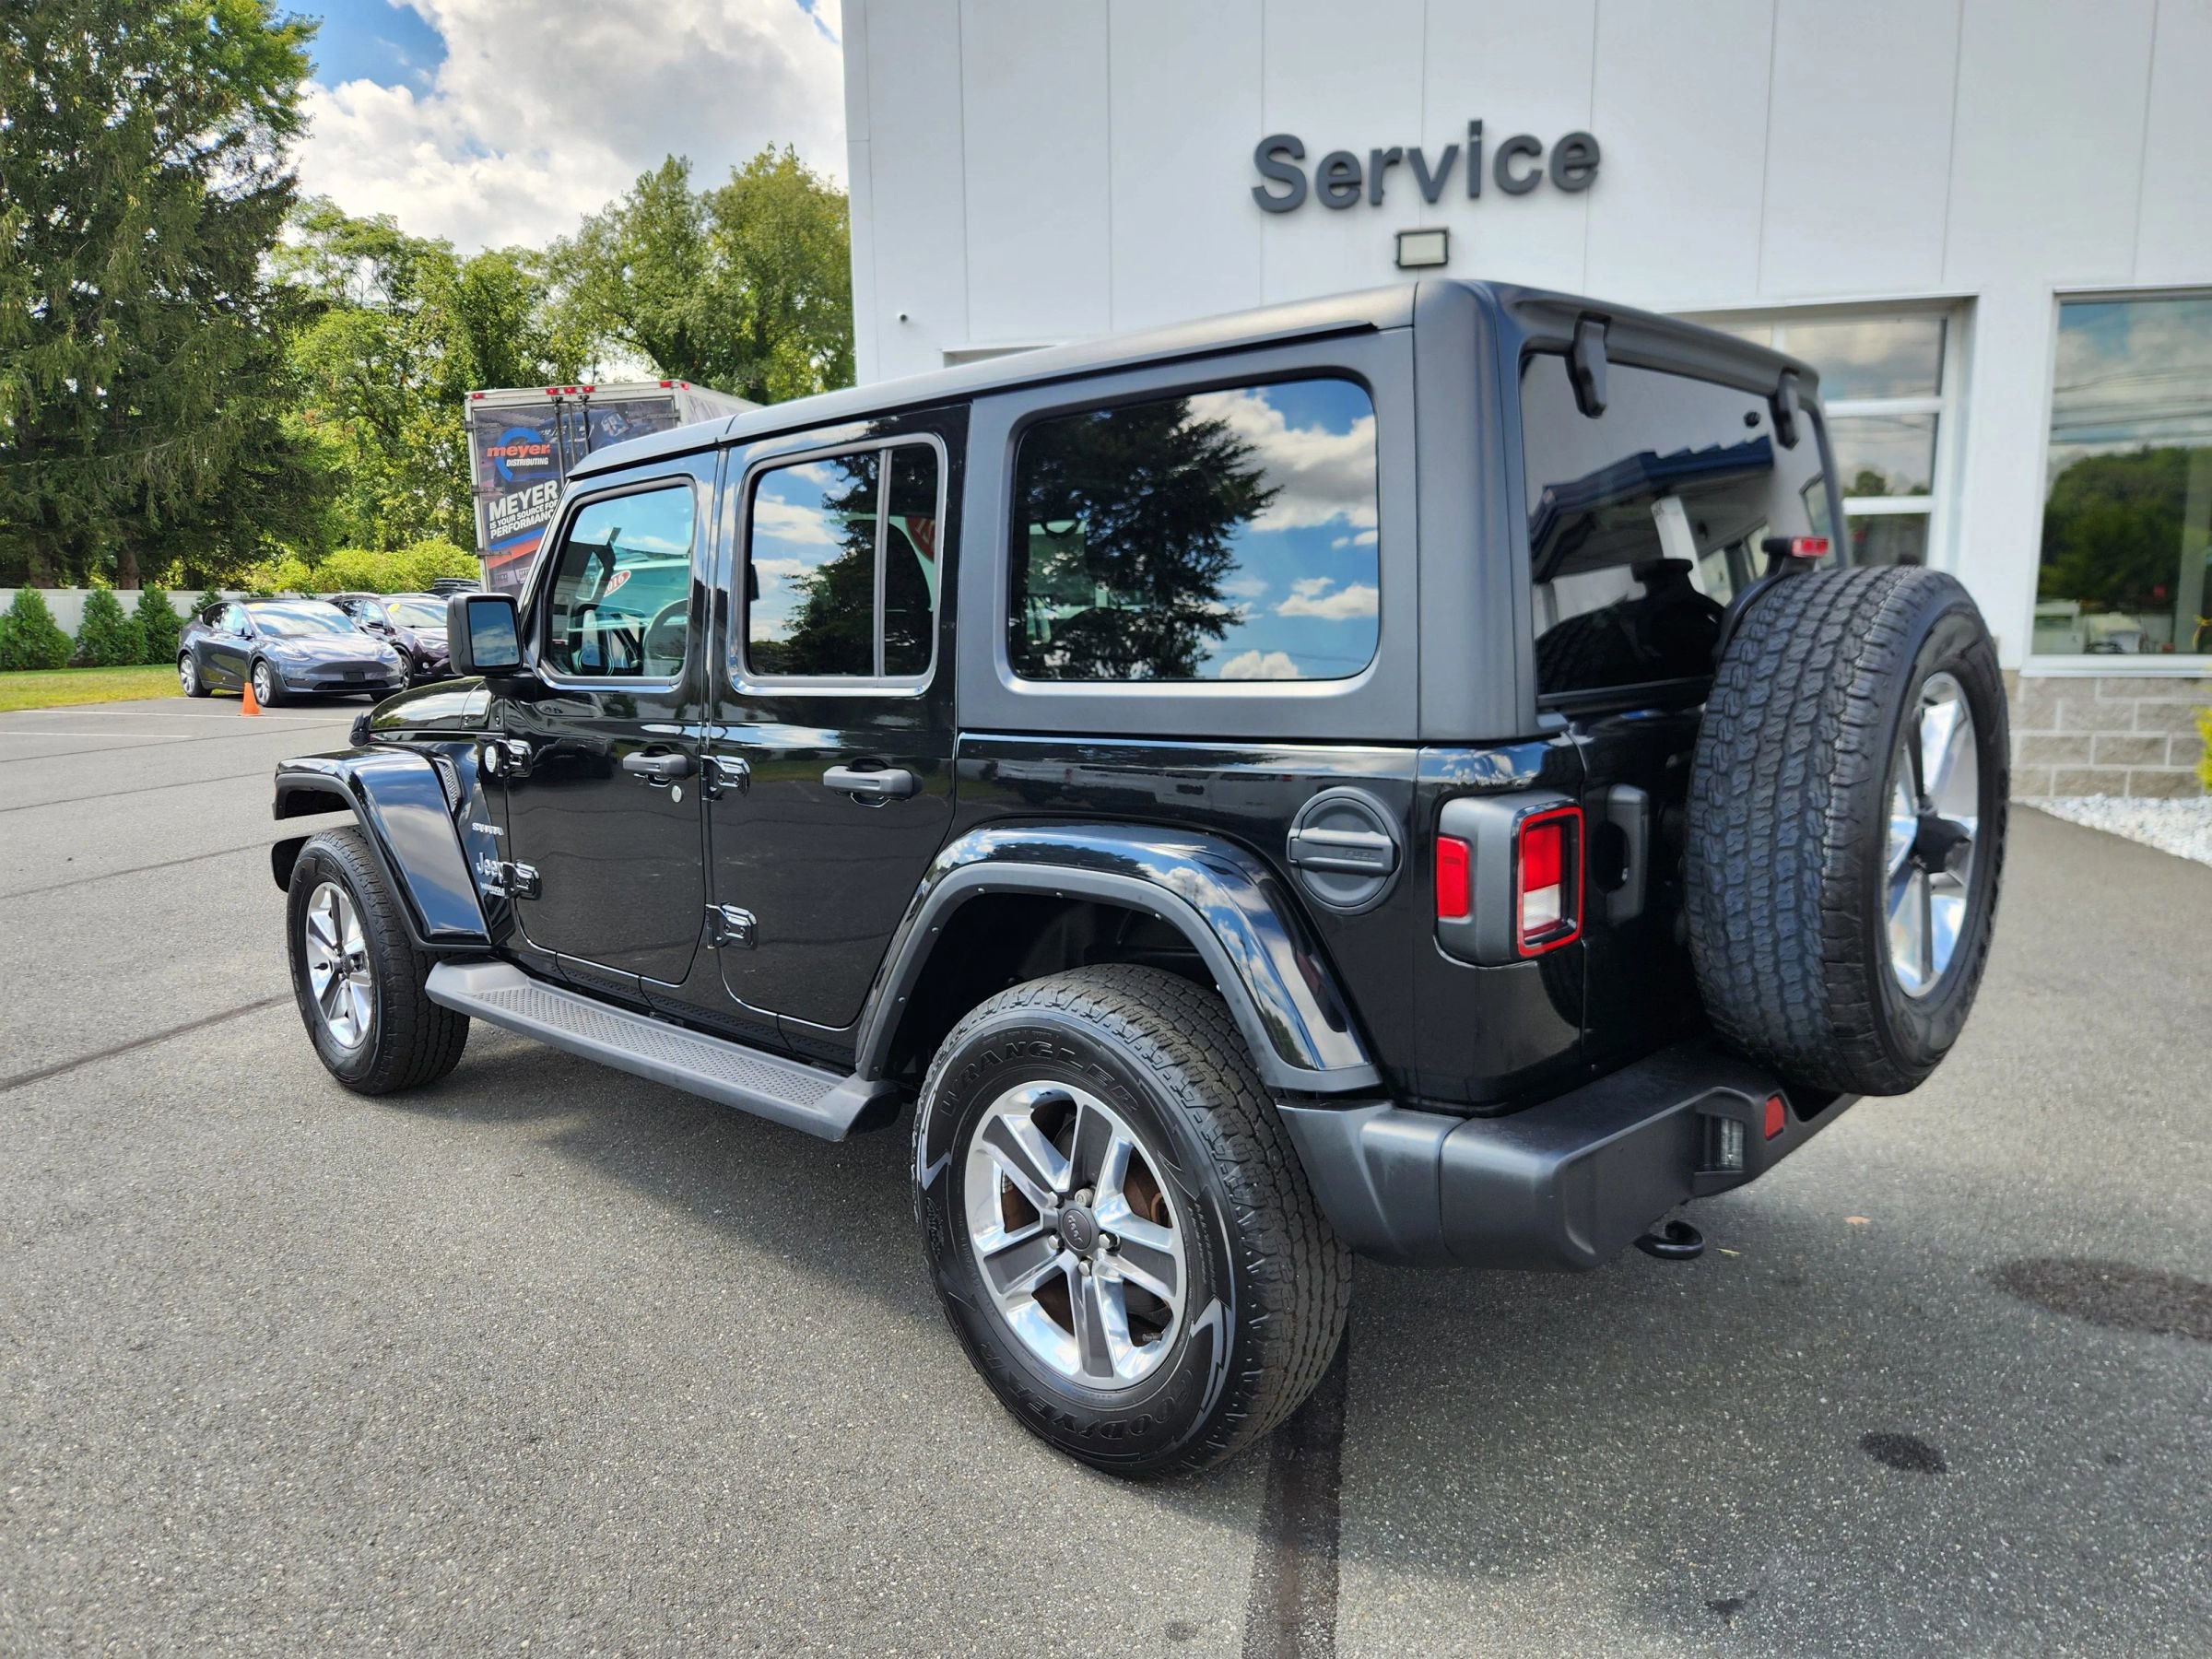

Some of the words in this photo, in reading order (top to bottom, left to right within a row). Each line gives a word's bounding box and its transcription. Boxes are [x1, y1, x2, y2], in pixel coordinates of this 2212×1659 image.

[1252, 118, 1602, 213] Service
[487, 444, 549, 458] meyer
[506, 457, 549, 467] DISTRIBUTING
[488, 480, 559, 522] MEYER
[489, 522, 497, 530] IS
[497, 512, 516, 527] YOUR
[516, 505, 543, 521] SOURCE
[490, 509, 554, 540] PERFORMANC
[476, 852, 503, 884] Jeep
[940, 1041, 1140, 1118] WRANGLER
[980, 1341, 1194, 1441] GOODYEAR
